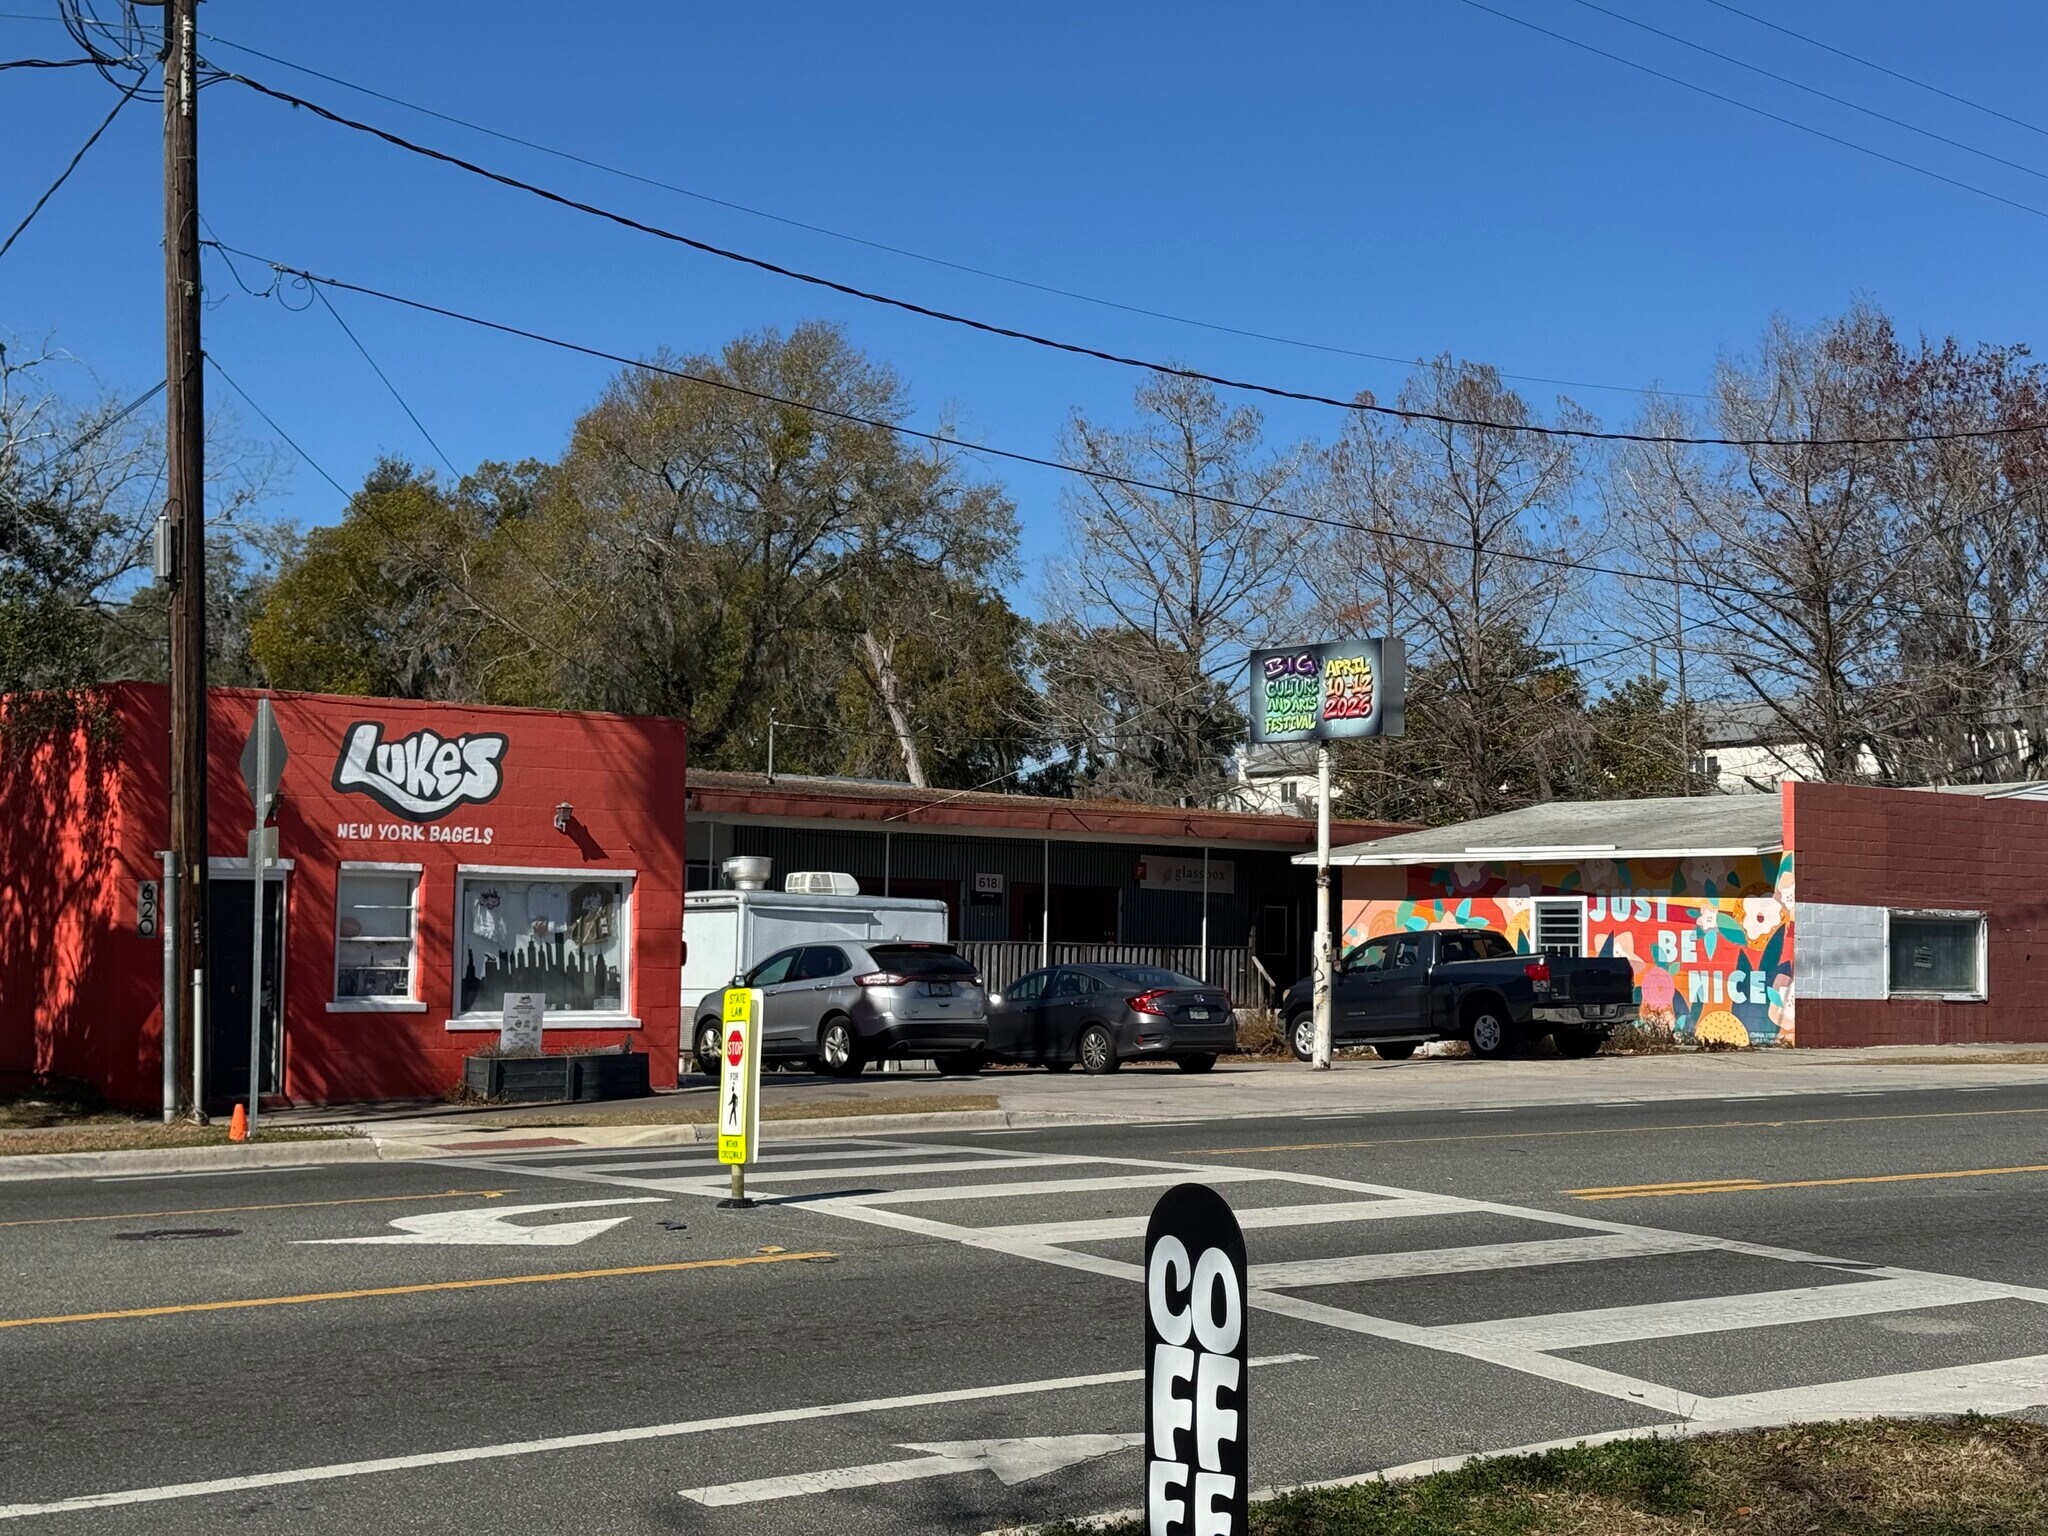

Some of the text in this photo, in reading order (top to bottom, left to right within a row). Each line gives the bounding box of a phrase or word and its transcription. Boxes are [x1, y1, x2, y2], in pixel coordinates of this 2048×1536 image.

[1263, 652, 1316, 677] BIG
[1325, 656, 1371, 677] APRIL
[1265, 678, 1319, 697] CULTURE
[1326, 674, 1373, 696] 10-12
[1267, 697, 1318, 713] AND ARTS
[1324, 695, 1372, 719] 2026
[1264, 715, 1317, 735] FESTIVAL
[337, 823, 494, 845] NEW YORK BAGELS
[978, 877, 998, 889] 618
[140, 883, 154, 936] 620
[1588, 888, 1672, 923] JUST
[1657, 929, 1699, 963] BE
[1687, 969, 1767, 1005] NICE
[729, 992, 747, 1005] STATE
[730, 1006, 743, 1018] LAW
[727, 1041, 744, 1056] STOP
[729, 1072, 739, 1081] FOR
